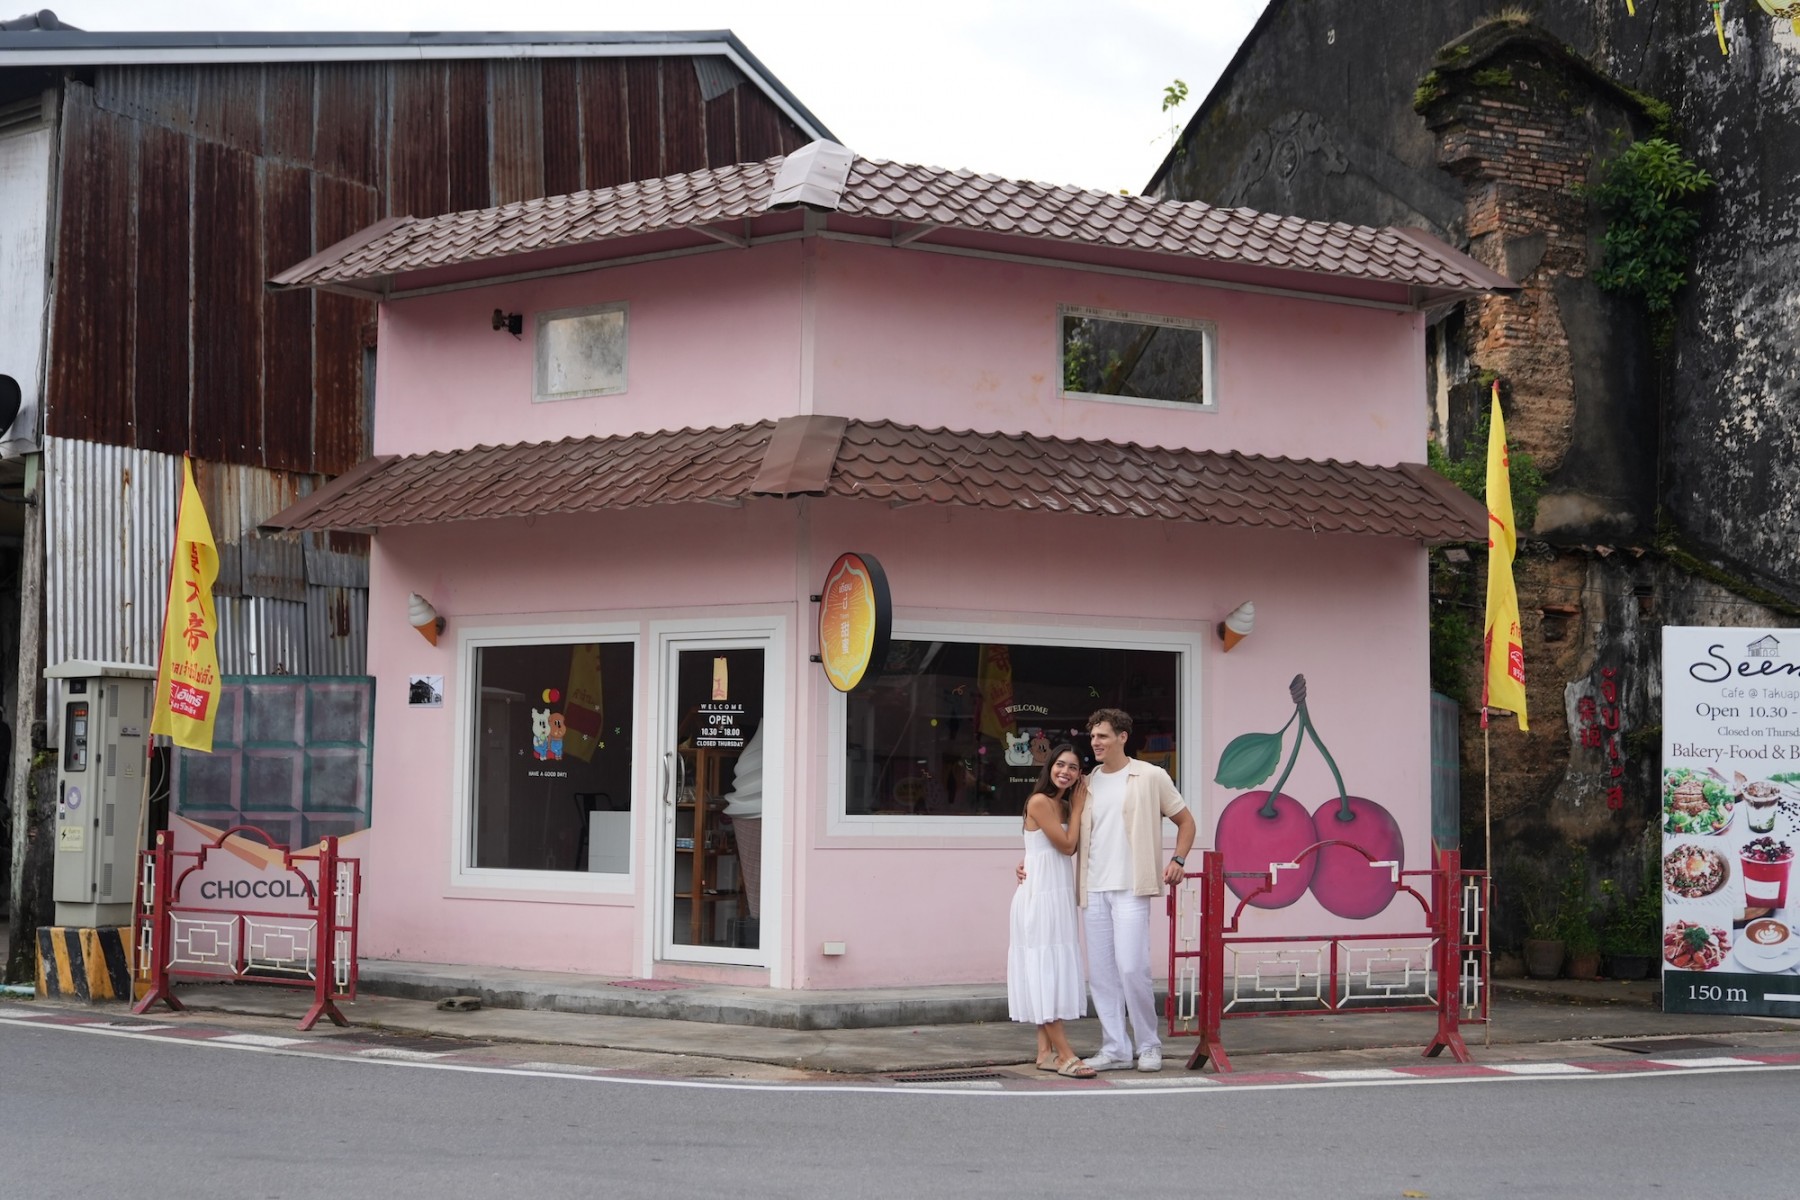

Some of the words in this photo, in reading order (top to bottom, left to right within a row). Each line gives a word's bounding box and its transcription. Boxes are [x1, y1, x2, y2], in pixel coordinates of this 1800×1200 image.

[1722, 688, 1744, 698] Cafe
[1748, 688, 1758, 698] @
[1004, 704, 1048, 716] WELCOME
[1696, 702, 1739, 720] Open
[1749, 706, 1787, 718] 10.30
[709, 715, 733, 725] OPEN
[1718, 726, 1749, 736] Closed
[1672, 743, 1768, 762] Bakery-Food
[1772, 746, 1786, 759] &
[201, 880, 345, 899] CHOCOLA
[1689, 985, 1722, 1001] 150
[1726, 988, 1748, 1002] m
